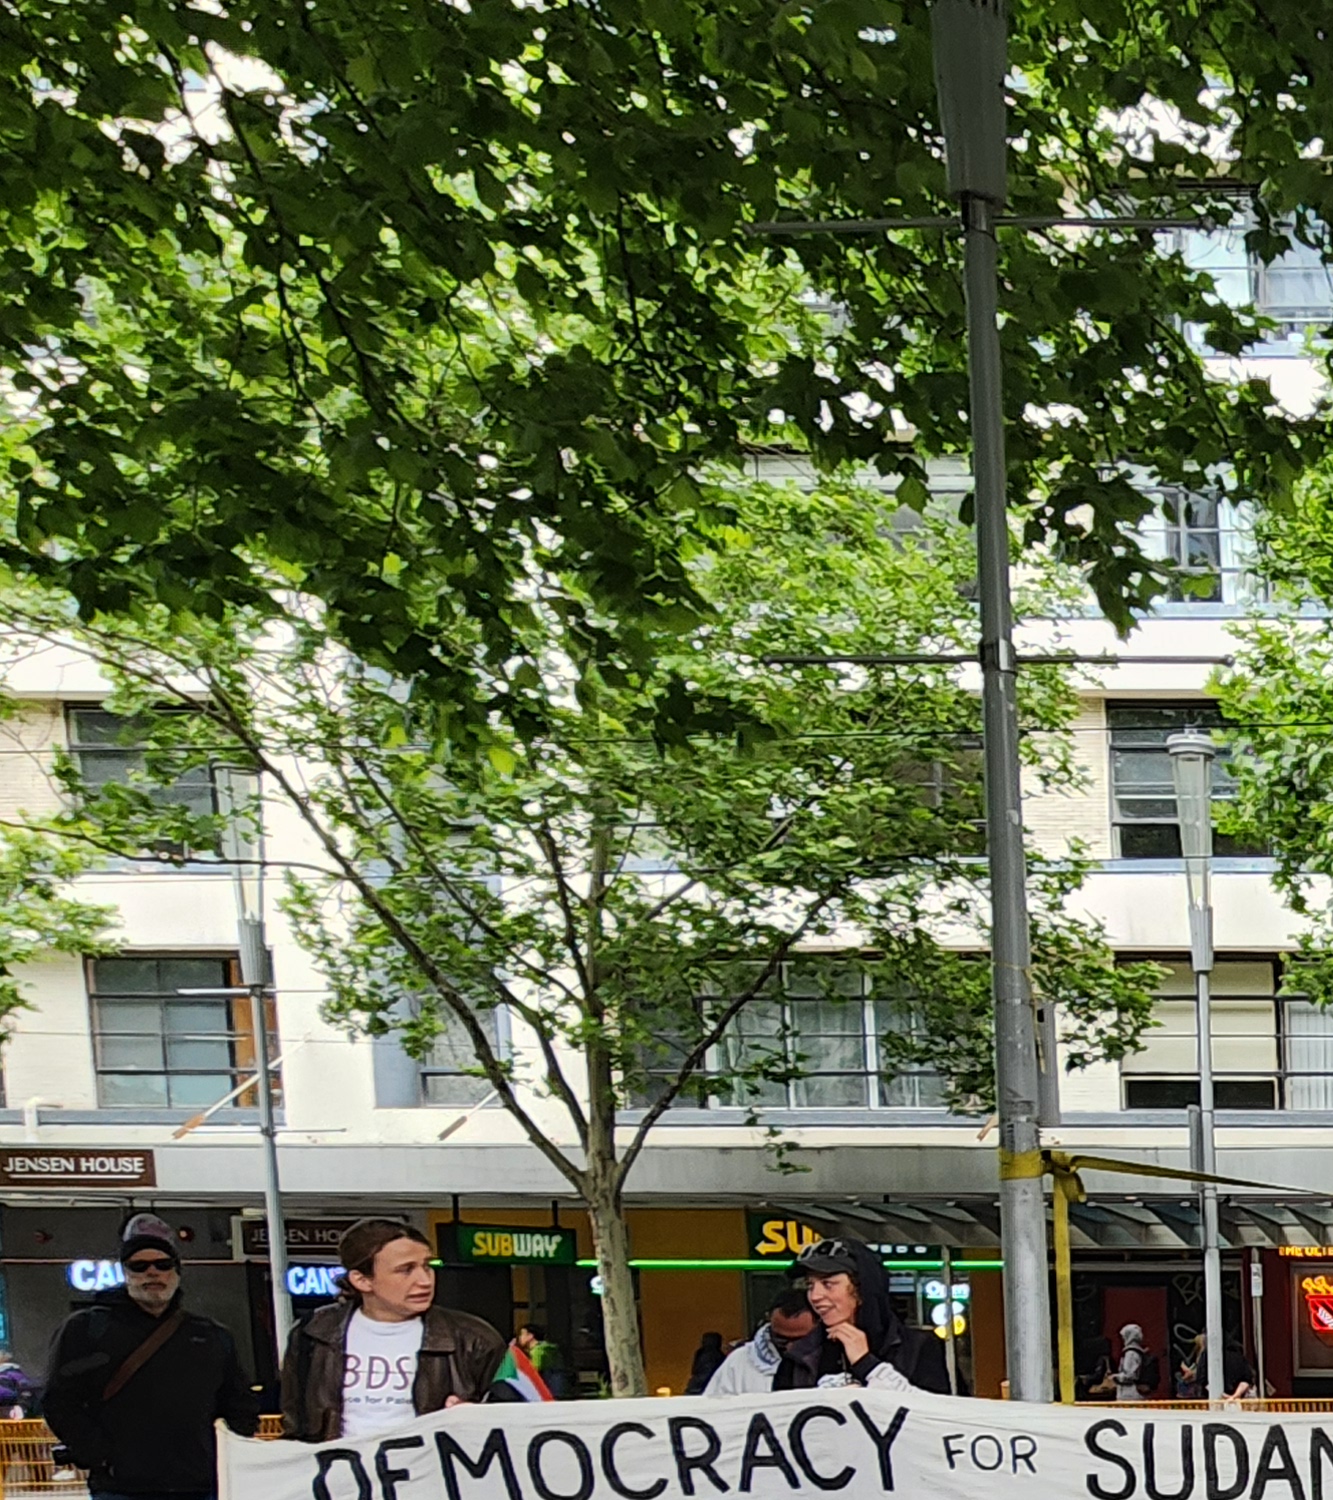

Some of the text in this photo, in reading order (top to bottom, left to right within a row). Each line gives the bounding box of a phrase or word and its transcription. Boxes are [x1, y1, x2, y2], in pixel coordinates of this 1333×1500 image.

[3, 1157, 146, 1173] JENSEN HOUSE
[472, 1231, 563, 1258] SUBWAY
[943, 1432, 1038, 1475] FOR
